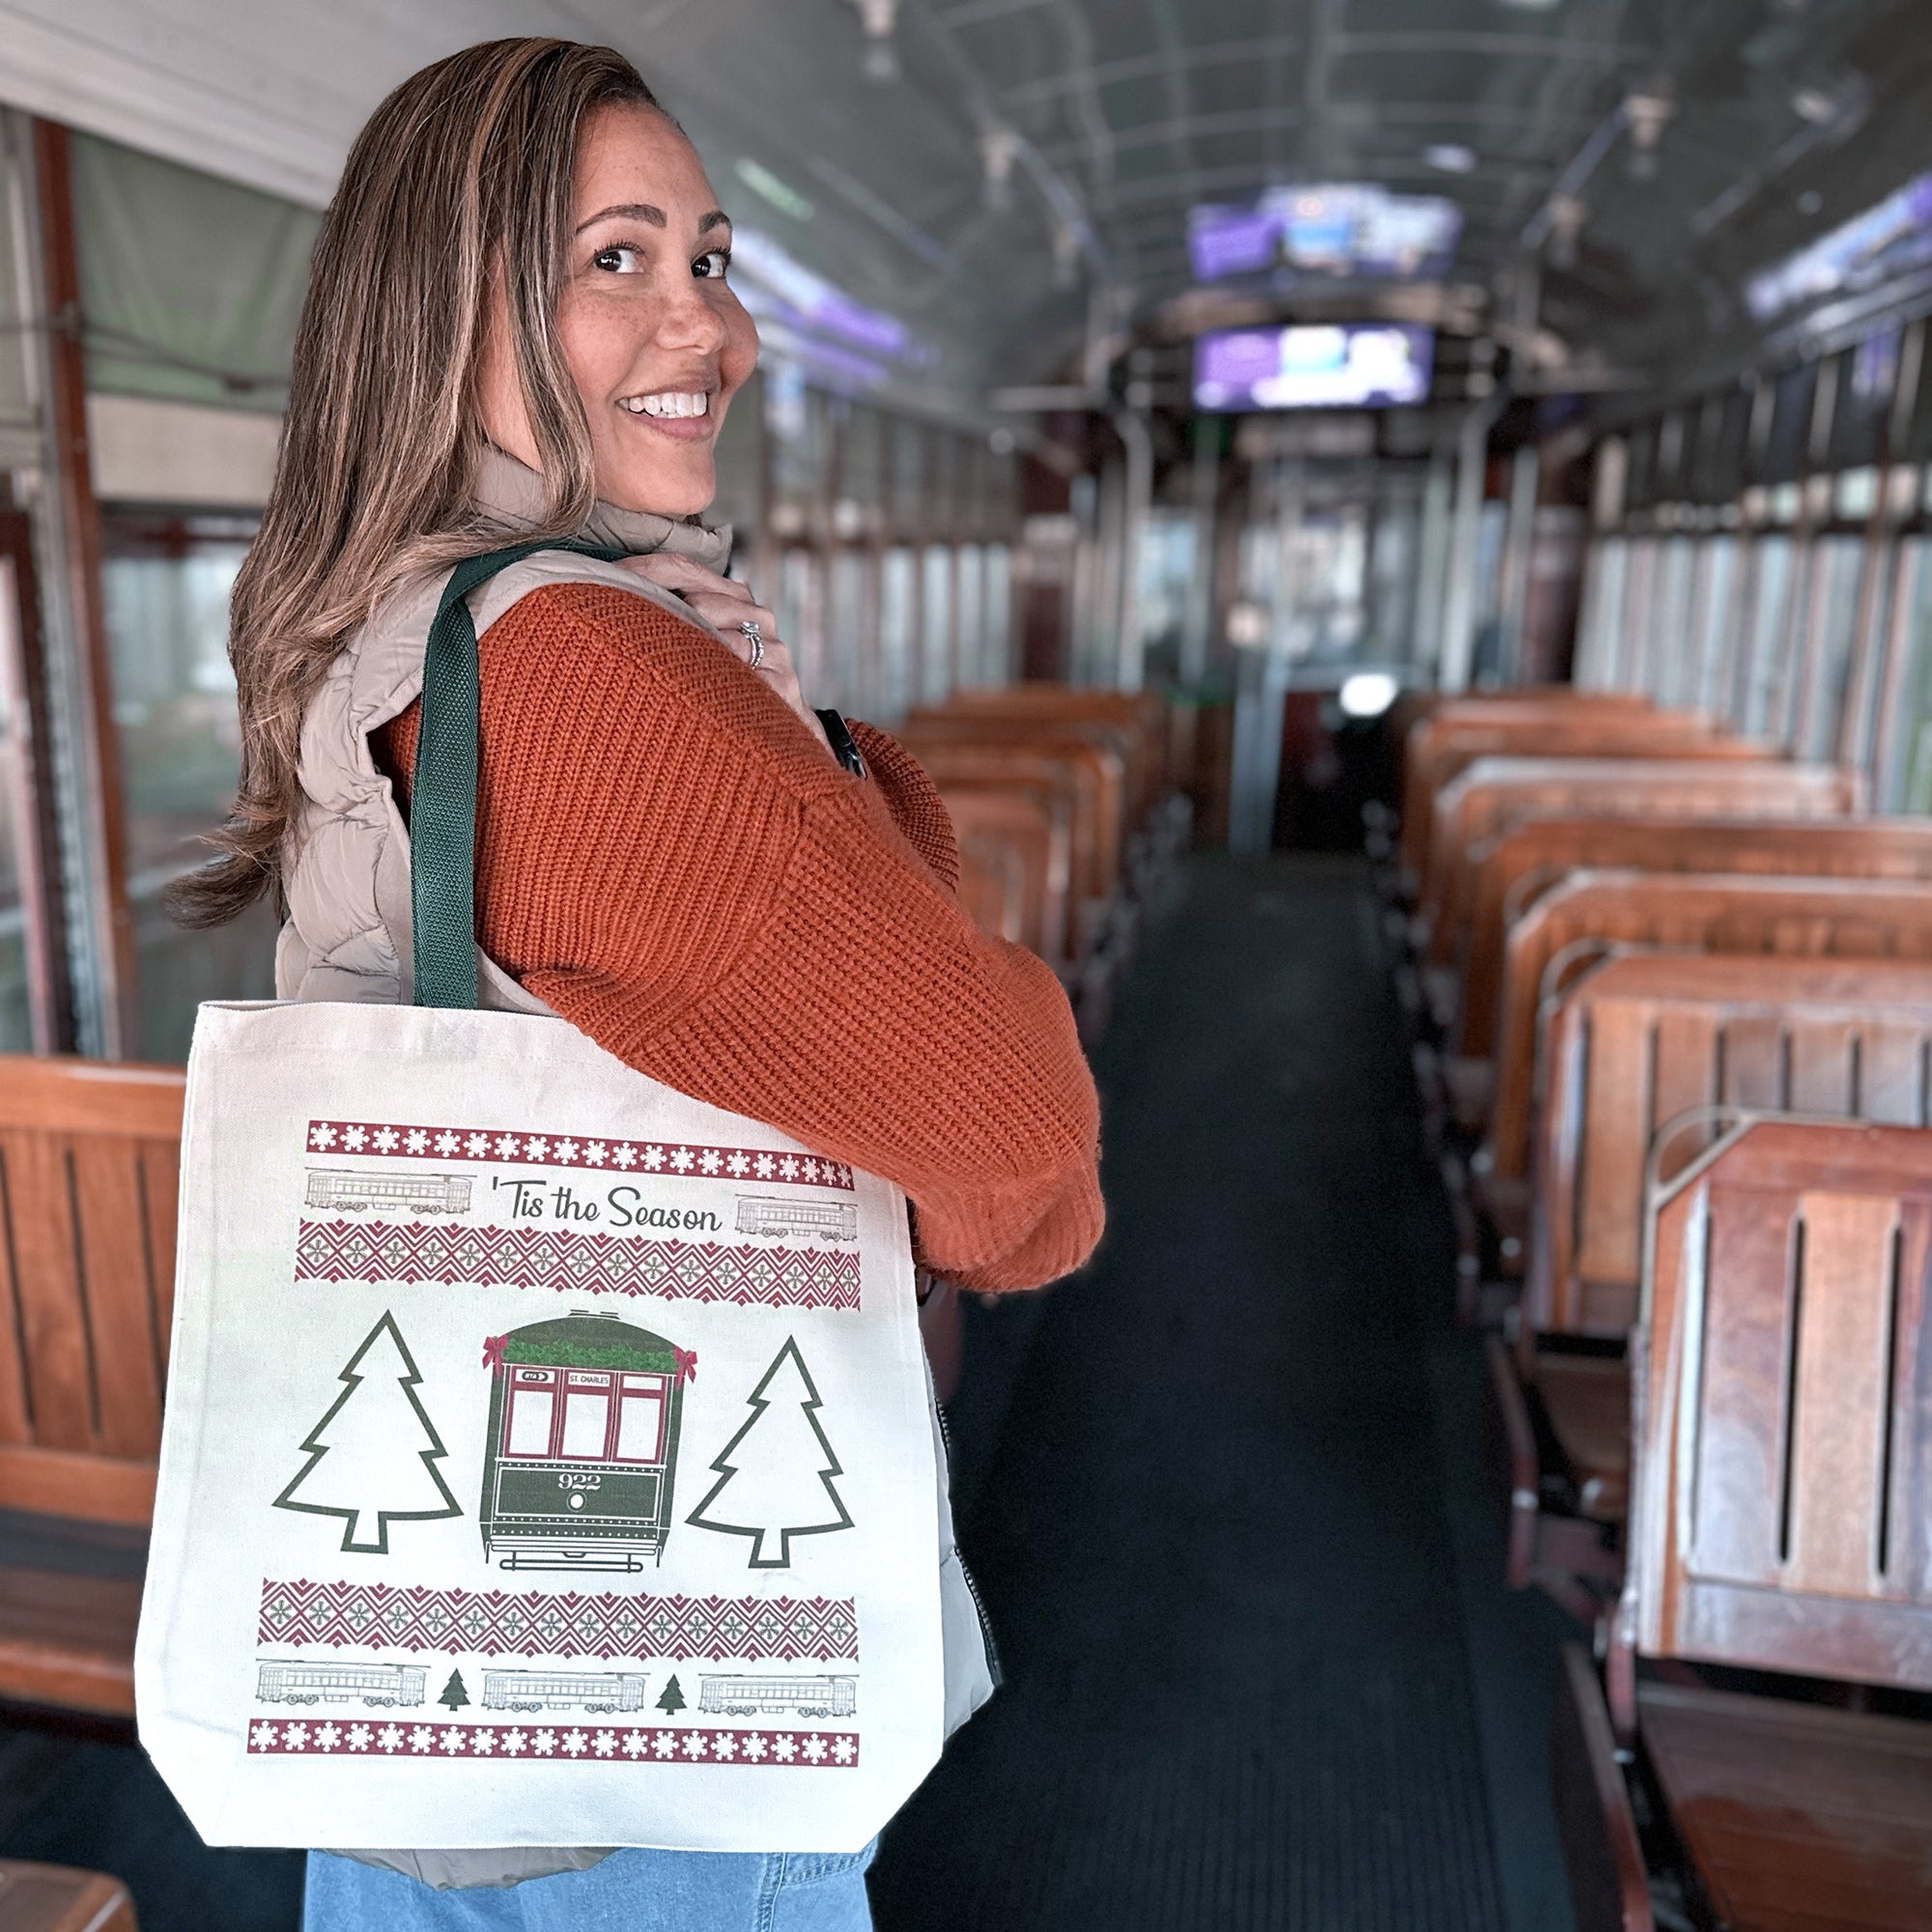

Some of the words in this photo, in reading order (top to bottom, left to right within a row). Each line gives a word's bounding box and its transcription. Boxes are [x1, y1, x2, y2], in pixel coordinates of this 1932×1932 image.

[493, 1176, 547, 1219] 'Tis
[551, 1186, 601, 1222] the
[608, 1186, 723, 1232] Season
[580, 1375, 610, 1385] CHARLES
[557, 1473, 602, 1491] 922
